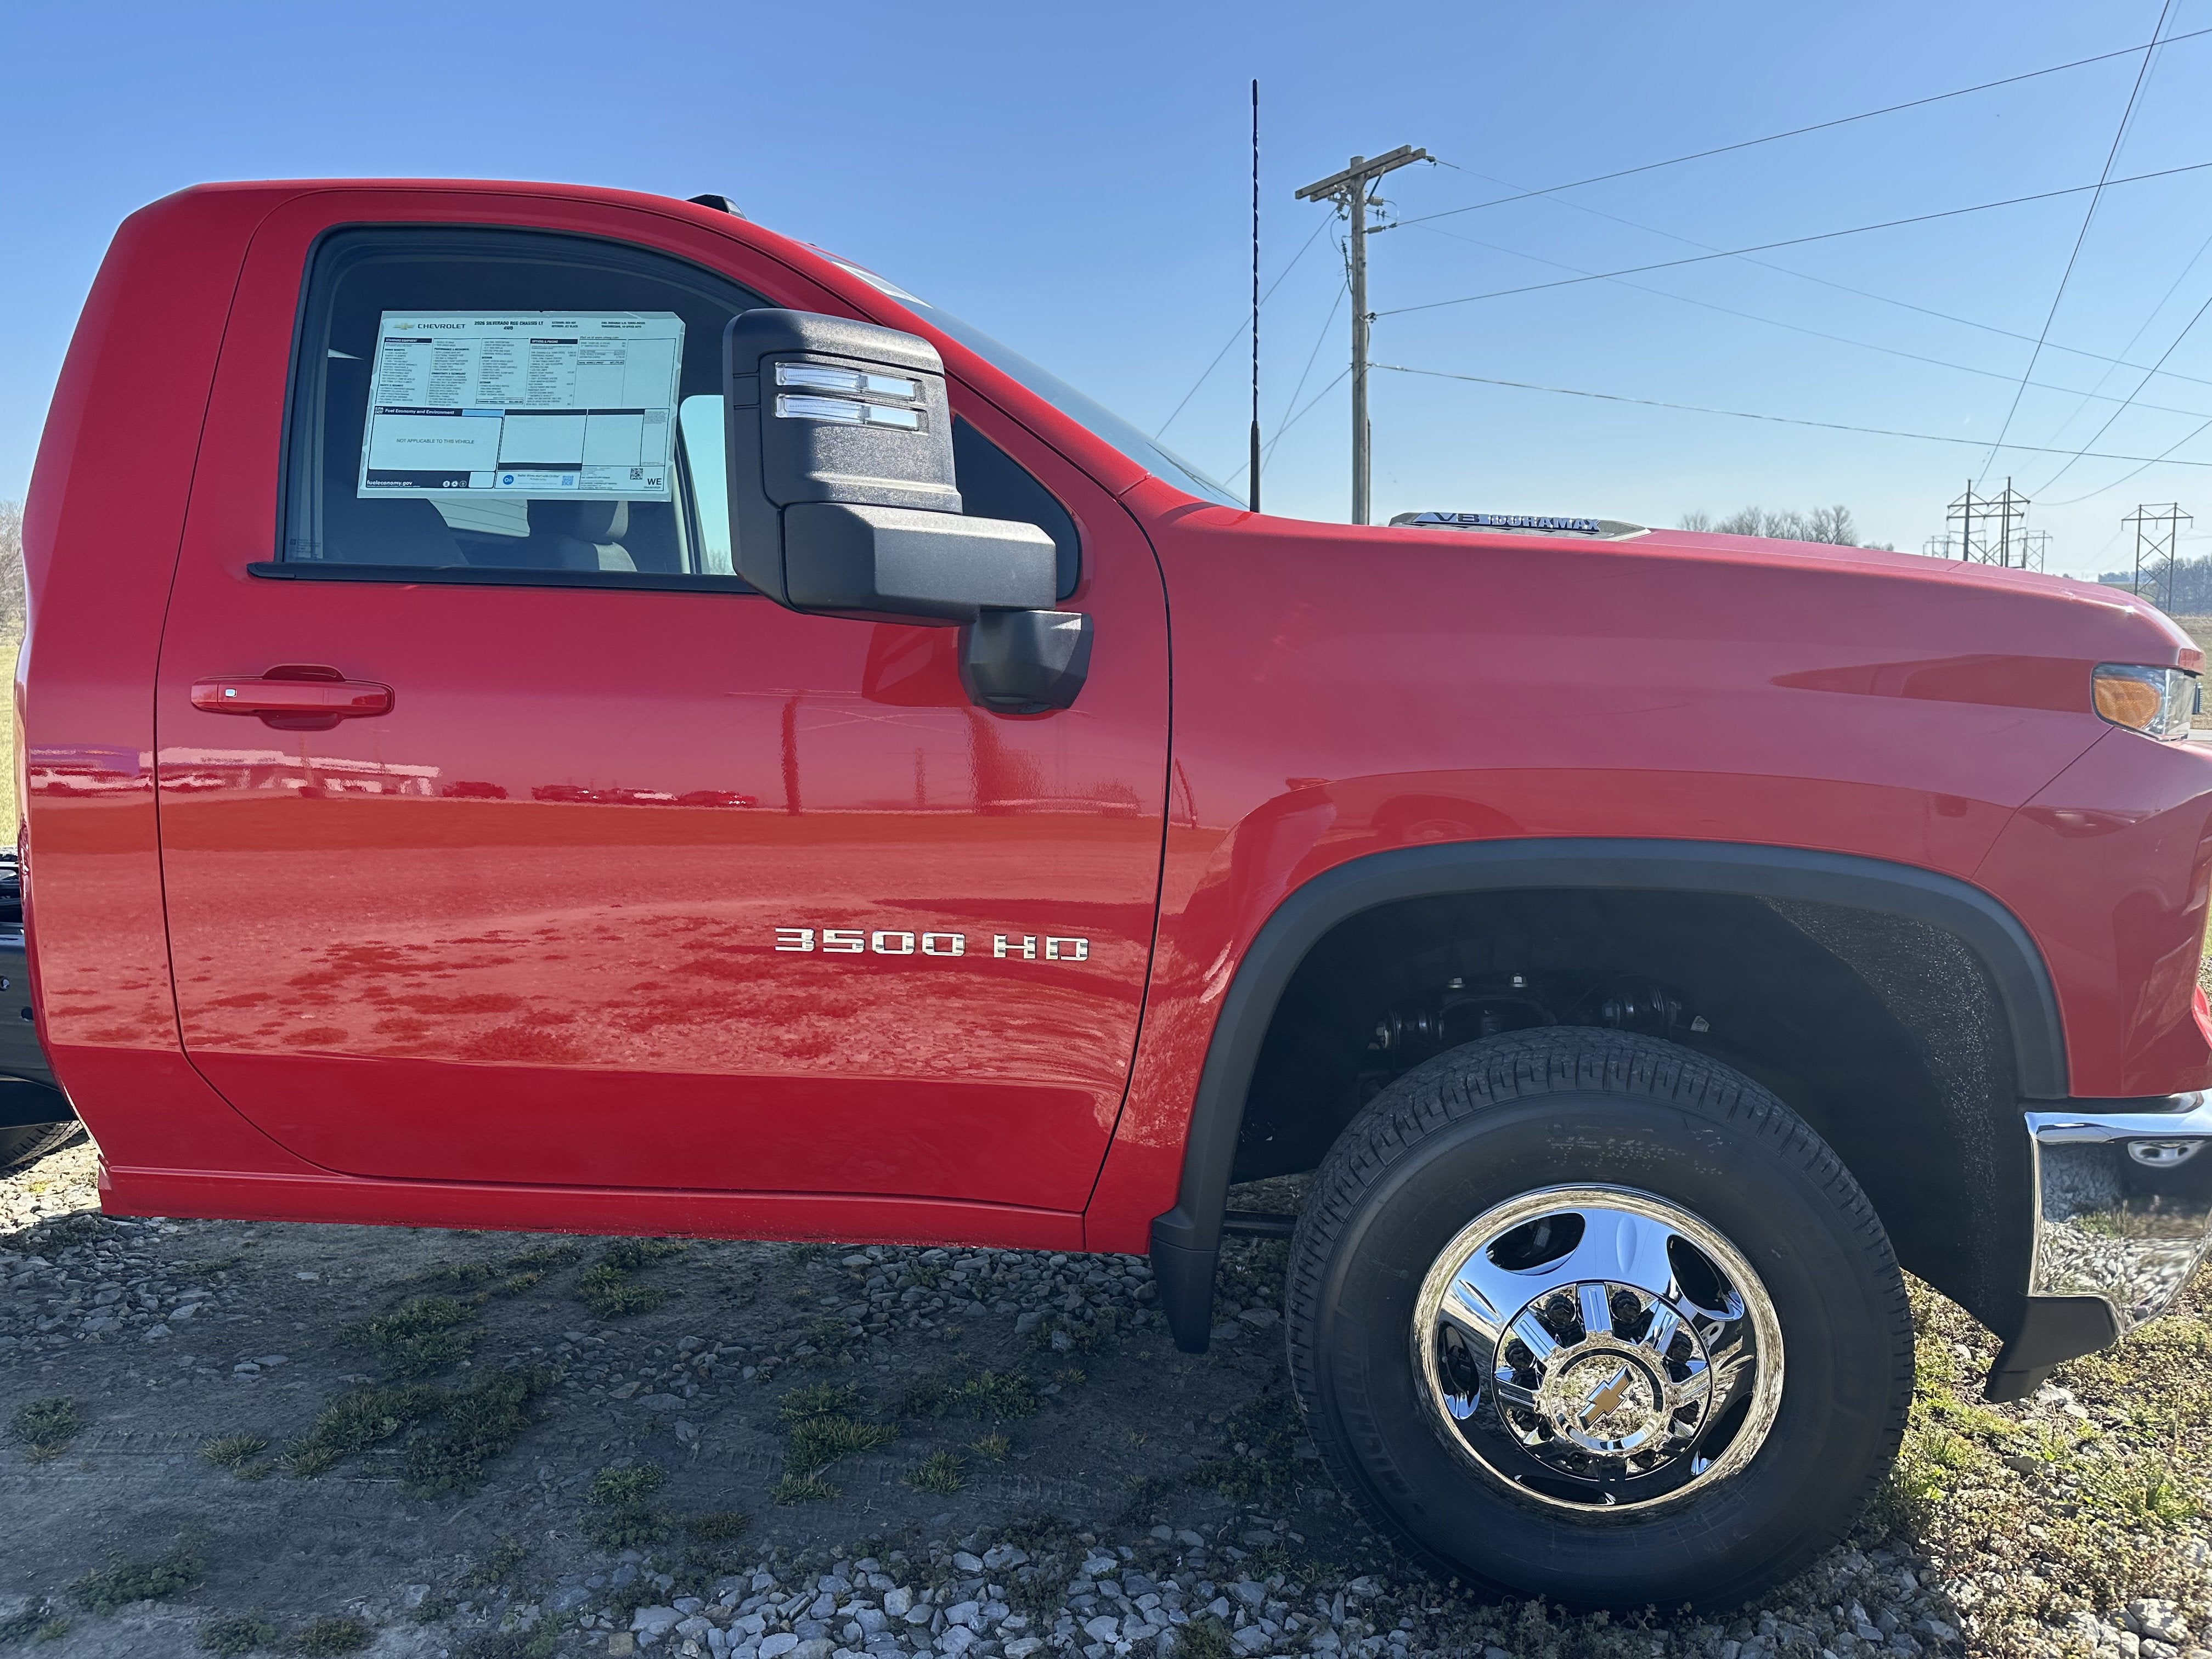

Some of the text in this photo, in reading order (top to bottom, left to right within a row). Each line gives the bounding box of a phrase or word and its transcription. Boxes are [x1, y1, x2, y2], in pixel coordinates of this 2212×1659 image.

[1489, 514, 1601, 532] DURAMAX
[775, 927, 1089, 961] 3500 HD
